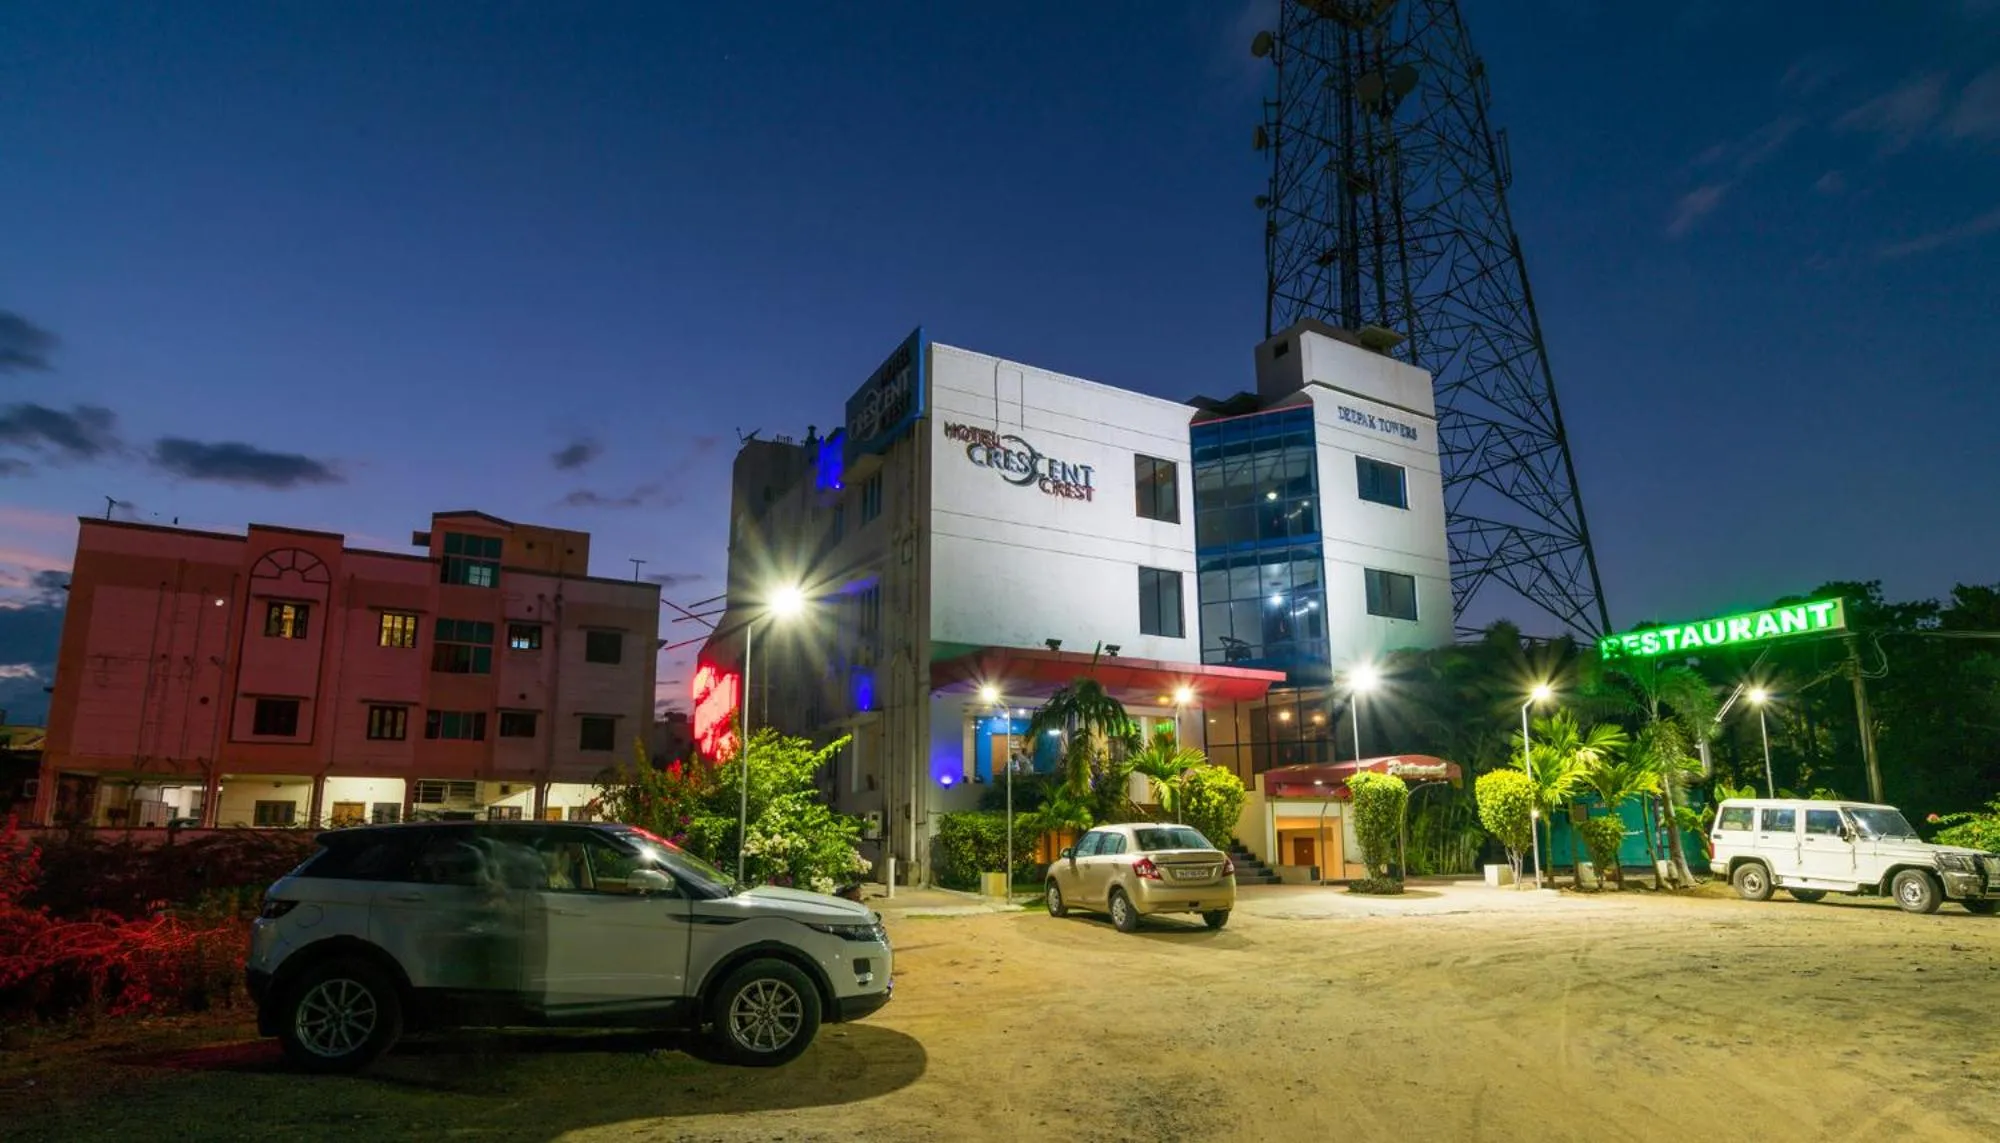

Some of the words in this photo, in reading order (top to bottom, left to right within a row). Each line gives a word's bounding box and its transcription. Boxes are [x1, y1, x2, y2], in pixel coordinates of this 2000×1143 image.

[944, 420, 1006, 450] HOTEL
[1337, 405, 1376, 430] DEEPAK
[1378, 417, 1418, 441] TOWERS
[966, 434, 1095, 487] CRESCENT
[1038, 476, 1095, 502] CREST
[1601, 601, 1834, 659] RESTAURANT
